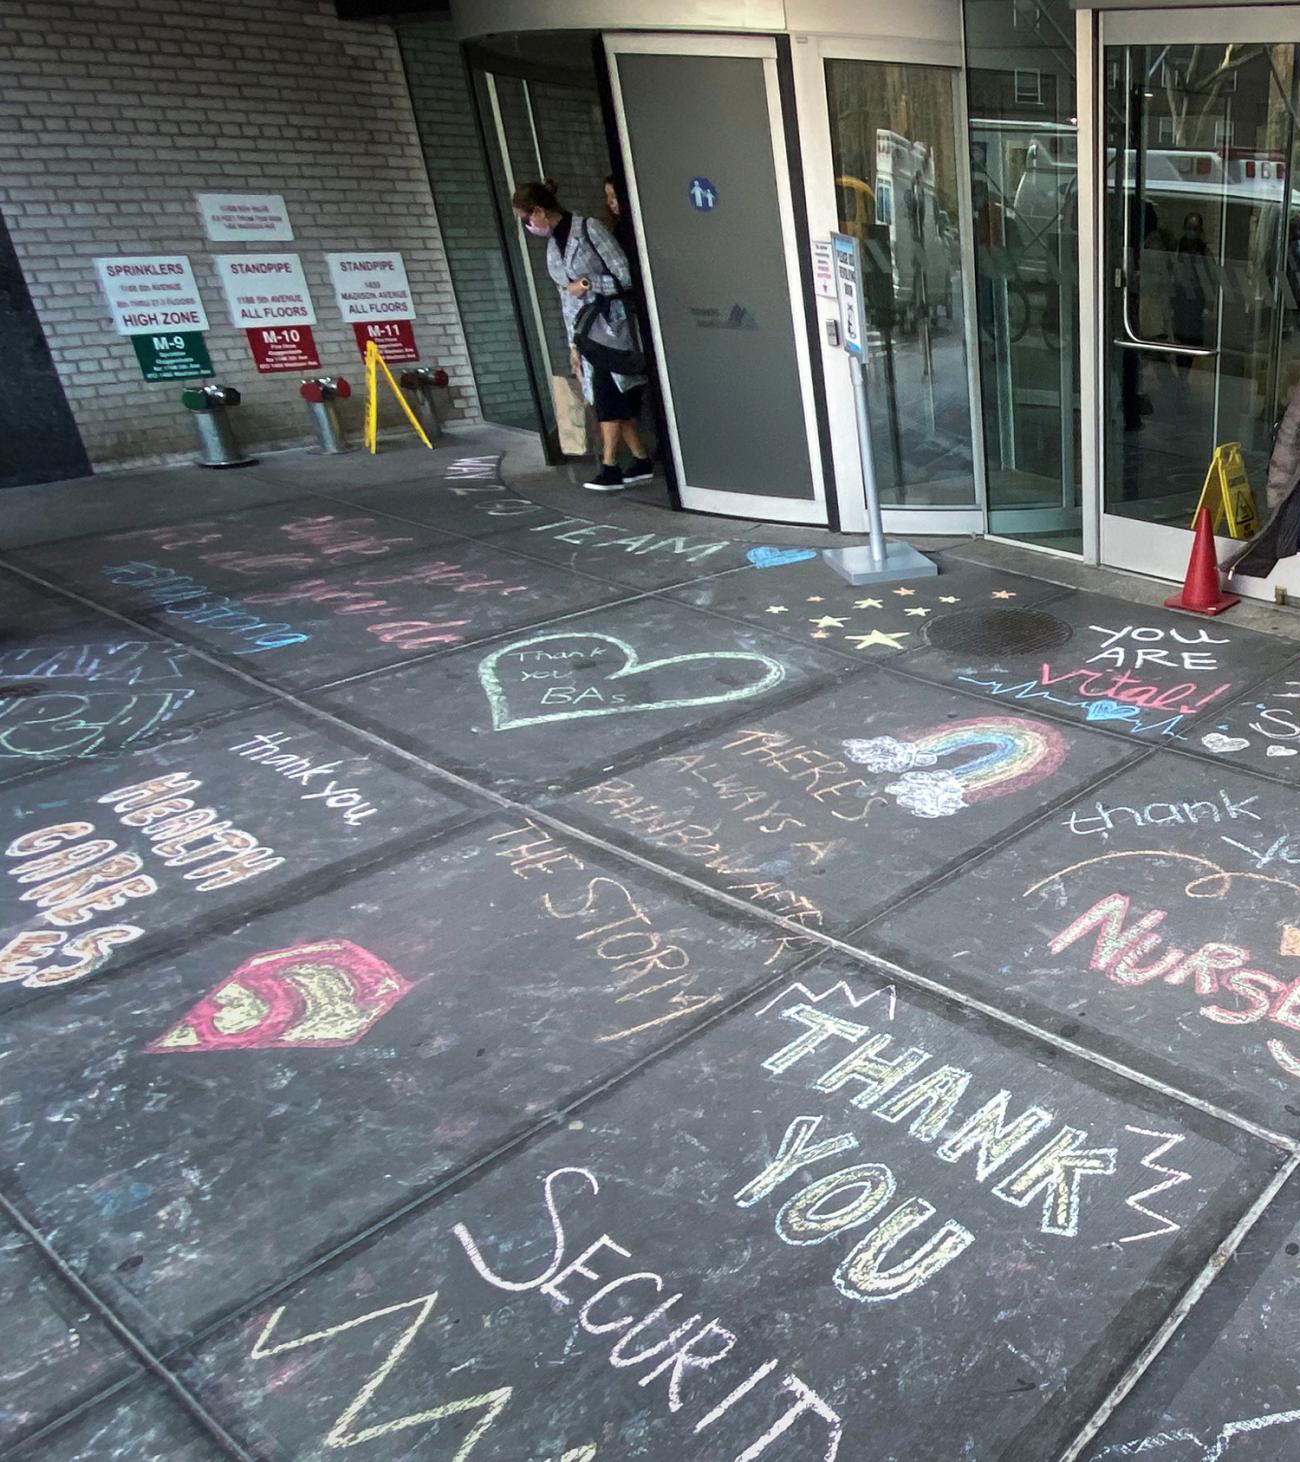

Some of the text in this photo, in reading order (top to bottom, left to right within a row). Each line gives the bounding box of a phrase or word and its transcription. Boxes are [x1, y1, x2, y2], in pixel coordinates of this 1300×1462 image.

[106, 262, 185, 277] SPRINKLERS
[230, 262, 293, 275] STANDPIPE
[340, 260, 395, 272] STANDPIPE
[240, 305, 308, 319] ALL FLOORS
[349, 302, 408, 314] ALL FLOORS
[122, 310, 200, 328] HIGH ZONE
[262, 329, 301, 344] M-10
[367, 324, 401, 338] M-11
[153, 335, 186, 351] M-9
[529, 516, 731, 563] TEAM
[507, 647, 607, 662] Thank
[1085, 647, 1218, 670] ARE
[540, 686, 627, 704] BAs
[228, 732, 378, 826] thank you
[656, 754, 847, 866] ALWAYS A
[1062, 790, 1260, 838] thank
[97, 771, 288, 892] HEALTH
[5, 821, 158, 927] CARE
[488, 817, 724, 1043] THE STORM
[760, 1003, 1119, 1238] THANK
[733, 1115, 976, 1302] YOU
